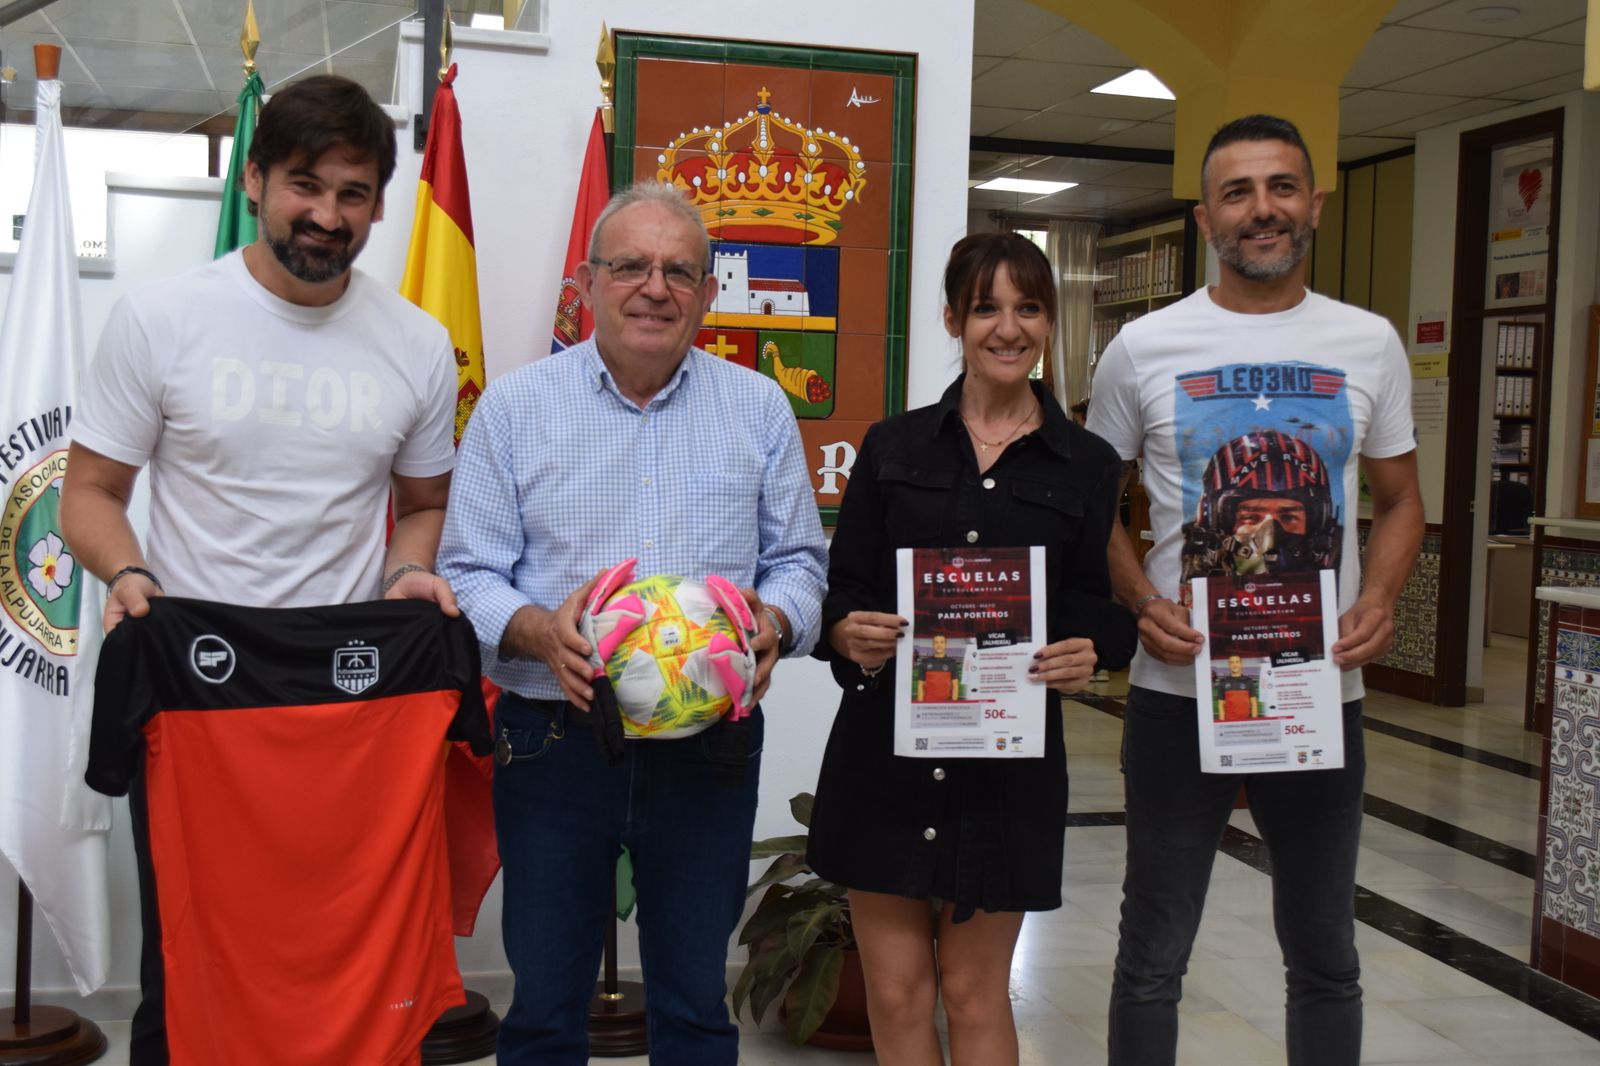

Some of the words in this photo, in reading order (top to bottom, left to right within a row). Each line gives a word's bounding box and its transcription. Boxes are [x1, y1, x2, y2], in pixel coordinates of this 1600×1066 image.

[1215, 366, 1312, 393] LEG3ND
[211, 357, 383, 434] DIOR
[1229, 453, 1317, 485] MAVERICK
[923, 570, 1021, 584] ESCUELAS
[1217, 593, 1312, 608] ESCUELAS
[2, 580, 63, 649] ALPUJARRA
[938, 612, 963, 620] PARA
[964, 610, 1009, 619] PORTEROS
[1231, 633, 1255, 641] PARA
[1256, 631, 1301, 640] PORTEROS
